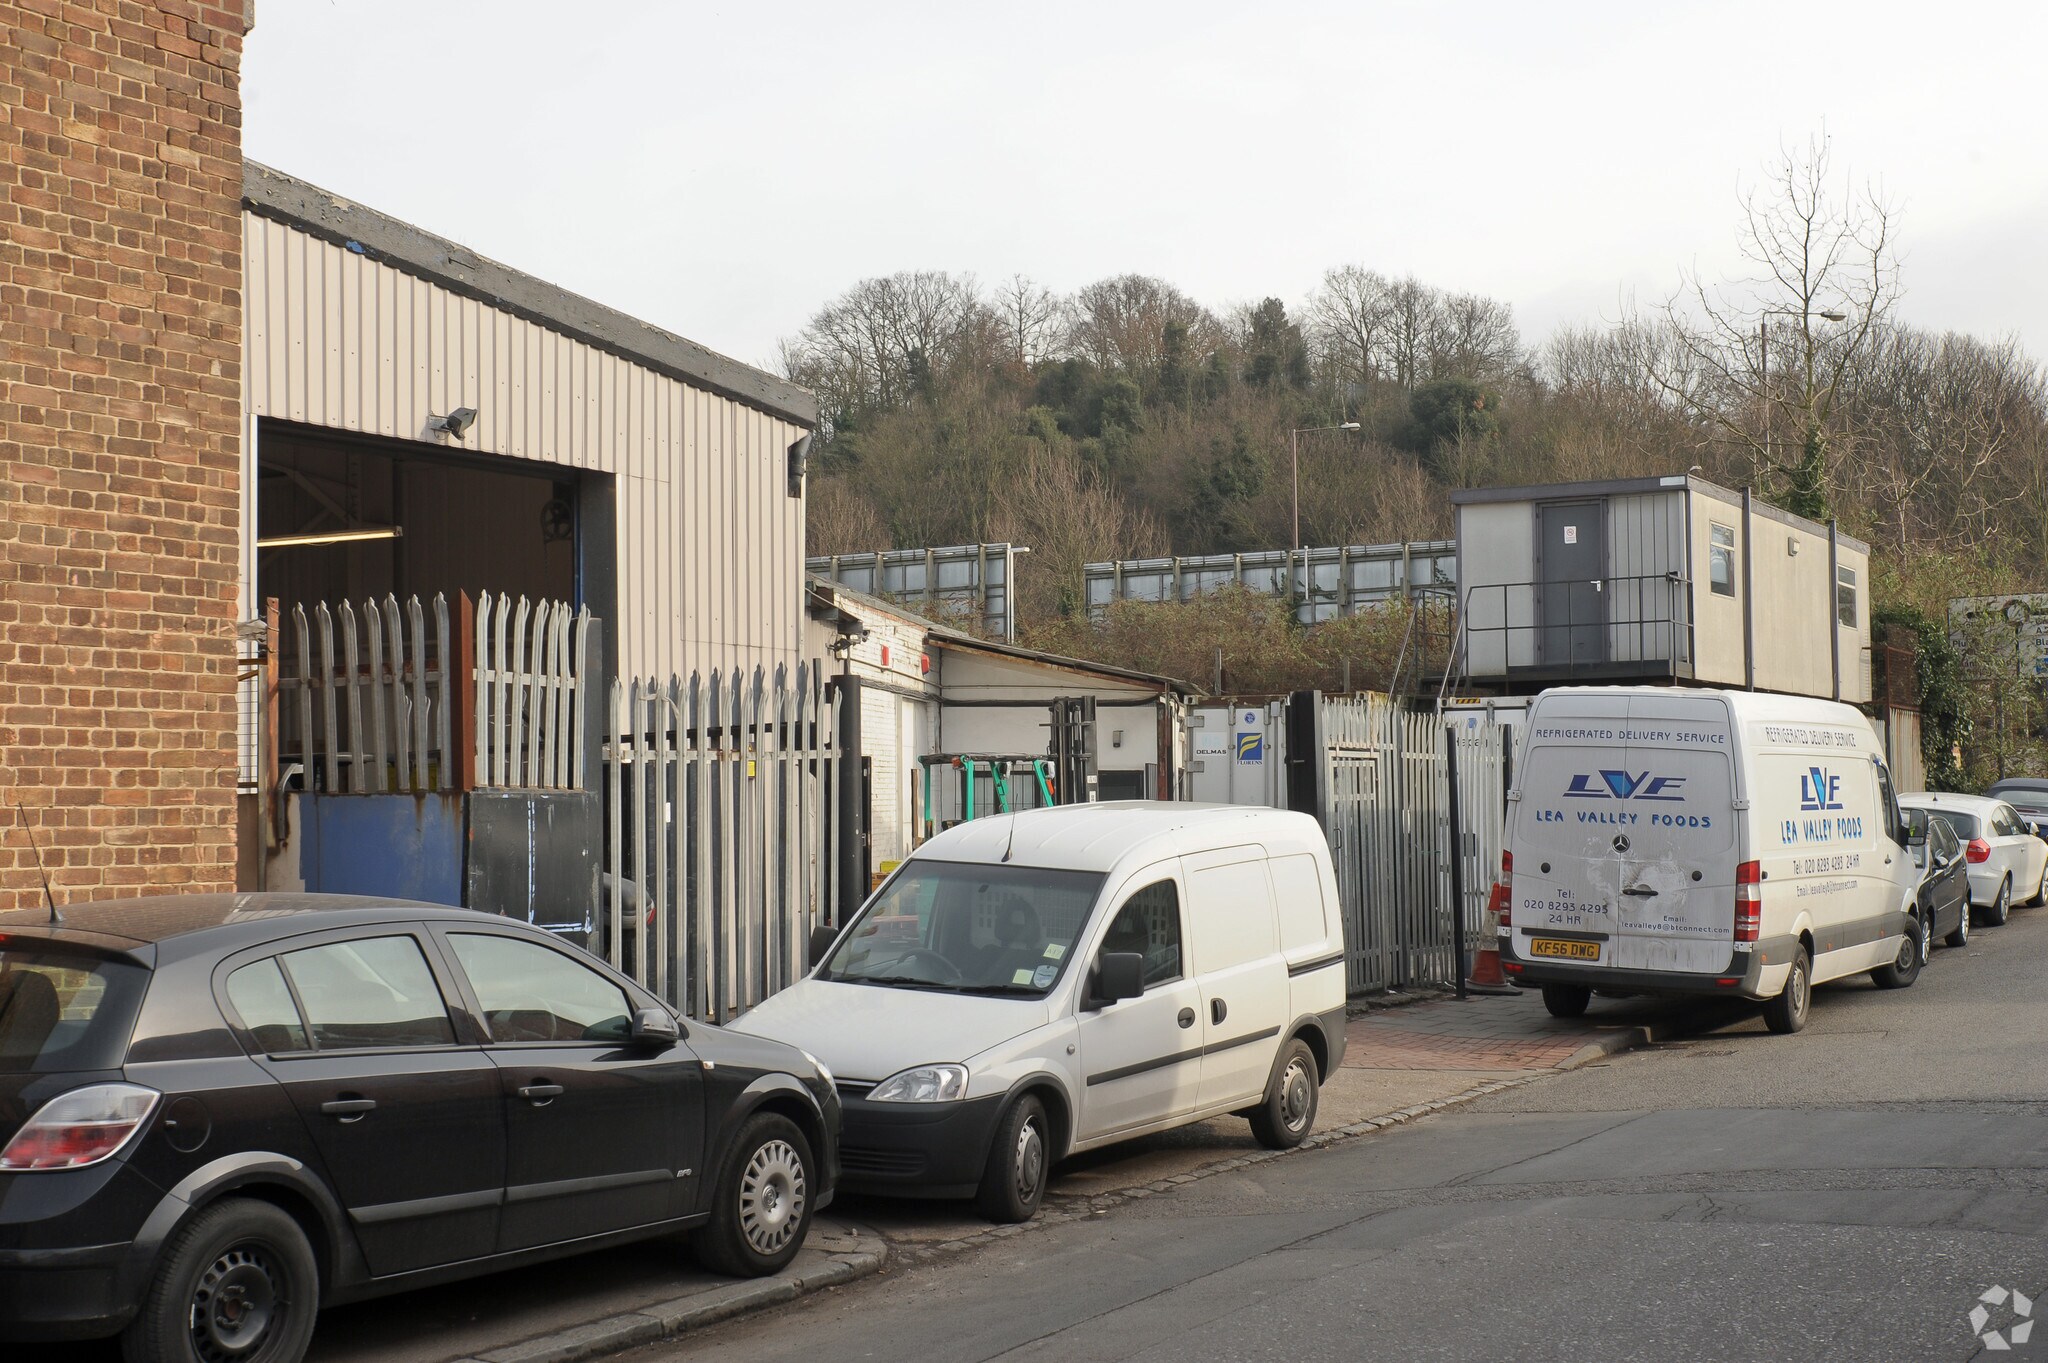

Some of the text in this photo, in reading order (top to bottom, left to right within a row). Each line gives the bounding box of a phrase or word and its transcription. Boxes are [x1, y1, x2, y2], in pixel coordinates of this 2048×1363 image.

[1535, 729, 1725, 744] REFRIGERATED DELIVERY SERVICE
[1765, 726, 1857, 748] REFRIGERATED DELIVERY SERVICE
[1536, 809, 1712, 829] LEA VALLEY FOODS
[1780, 816, 1863, 844] LEA VALLEY FOODS
[1804, 859, 1816, 874] 020
[1556, 888, 1575, 899] Tel:
[1523, 899, 1544, 910] 020
[1547, 901, 1576, 912] 8293
[1548, 913, 1582, 925] 24 HR
[1663, 915, 1687, 923] Email:
[1621, 921, 1730, 934] leavalley8@btconnect.com
[1535, 941, 1568, 955] KF56
[1570, 943, 1595, 957] DWG
